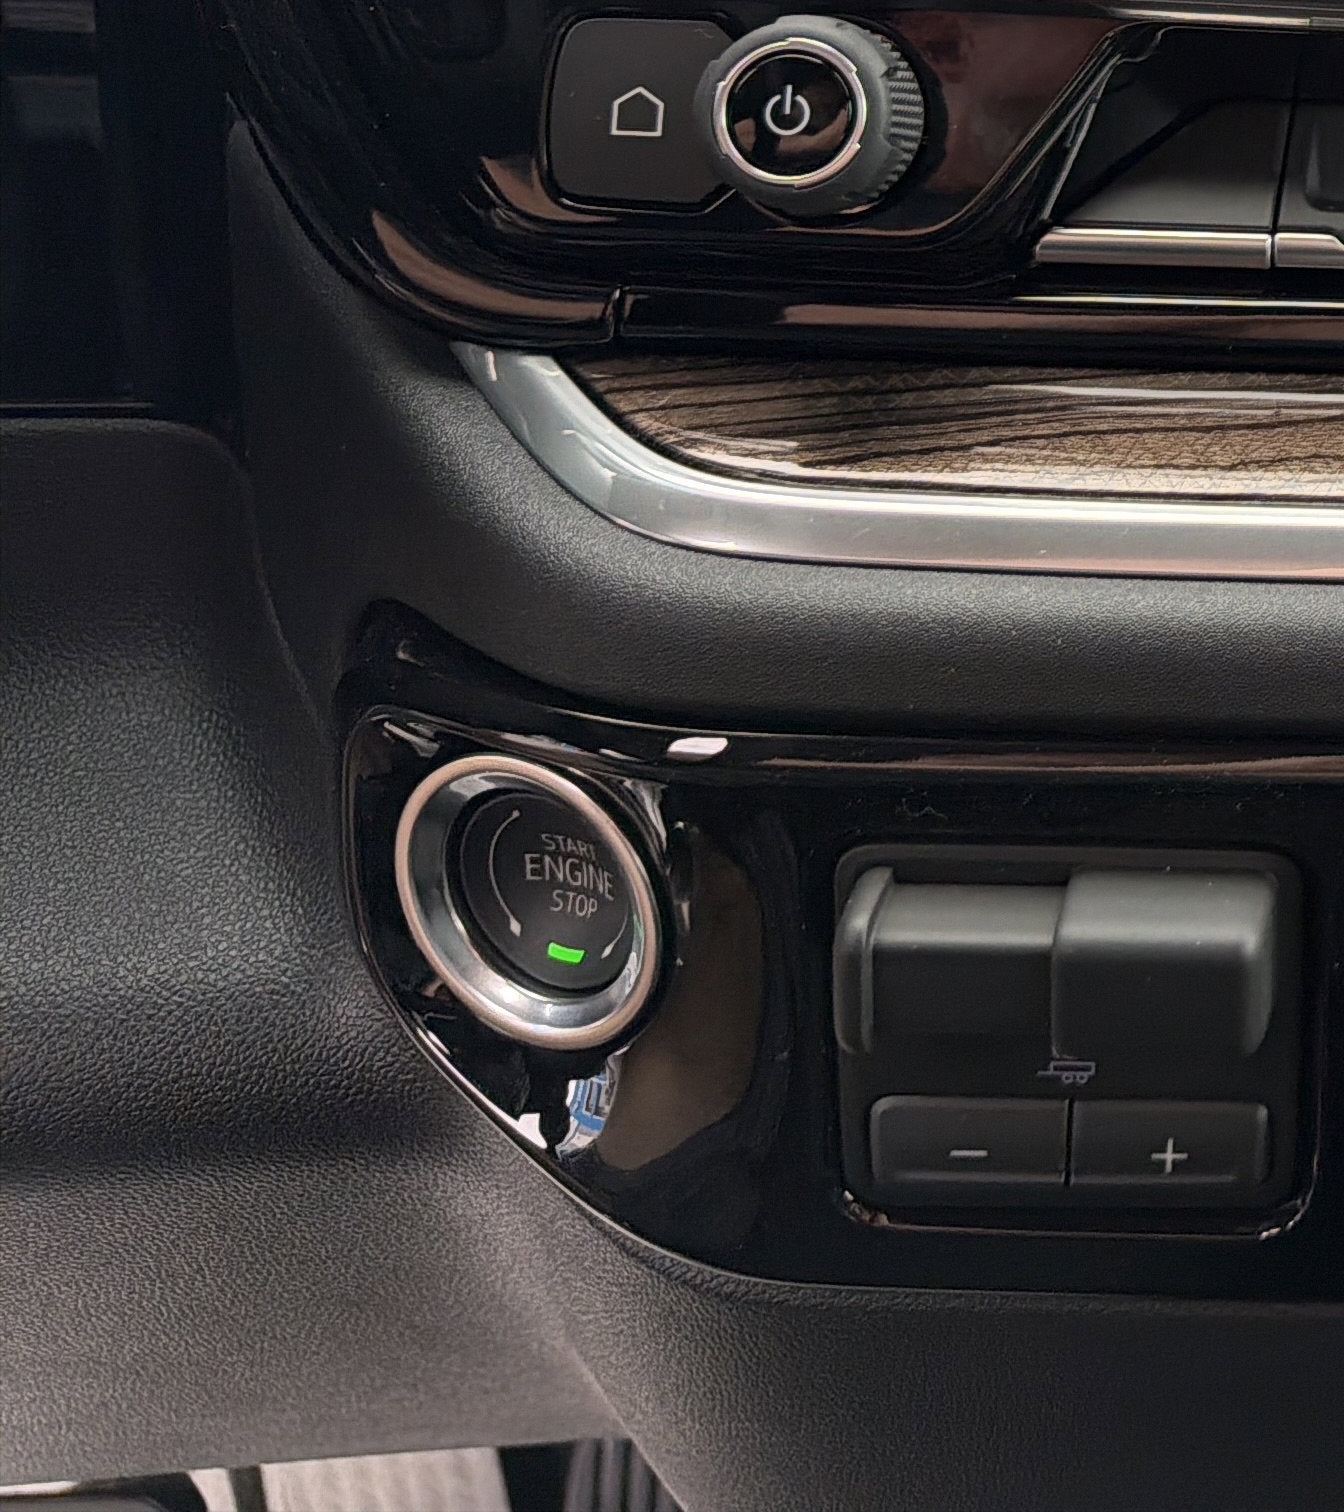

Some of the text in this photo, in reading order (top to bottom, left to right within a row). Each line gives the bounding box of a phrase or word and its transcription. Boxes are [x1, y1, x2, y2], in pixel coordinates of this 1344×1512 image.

[541, 833, 597, 861] START
[524, 853, 615, 901] ENGINE
[550, 889, 598, 919] STOP
